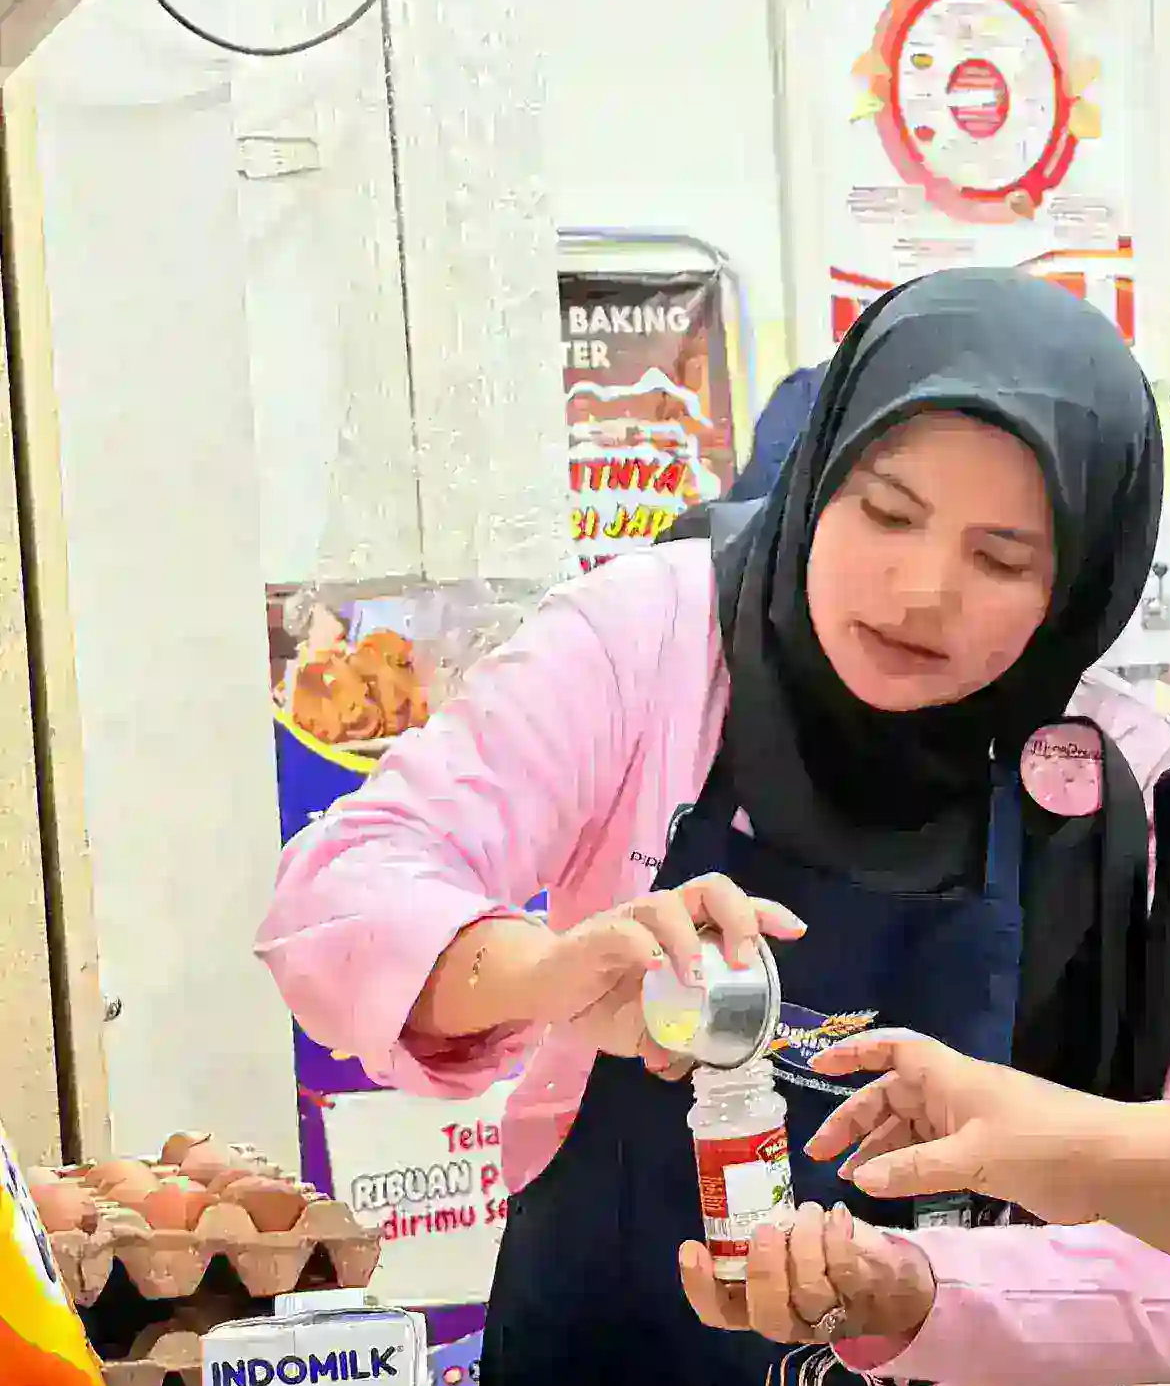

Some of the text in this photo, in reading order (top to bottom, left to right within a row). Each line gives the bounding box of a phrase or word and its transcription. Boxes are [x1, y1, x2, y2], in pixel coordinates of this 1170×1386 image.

[568, 305, 690, 335] BAKING
[351, 1158, 473, 1213] RIBUAN
[380, 1204, 475, 1241] dirimu
